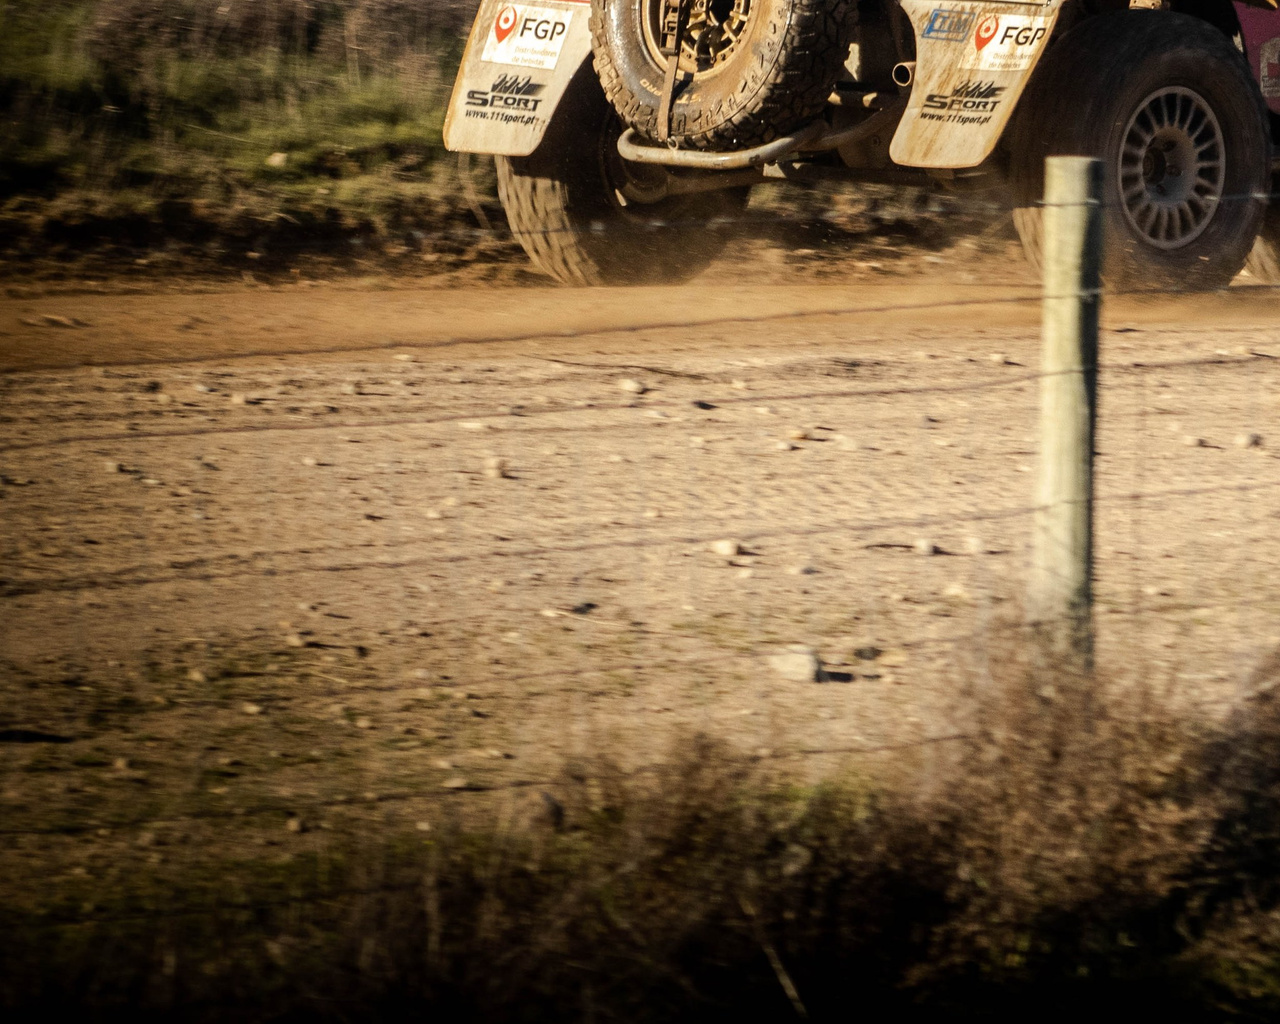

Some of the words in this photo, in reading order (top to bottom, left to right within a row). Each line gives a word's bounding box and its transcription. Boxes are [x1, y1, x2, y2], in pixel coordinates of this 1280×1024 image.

[519, 17, 566, 41] FGP
[999, 26, 1047, 46] FGP
[464, 89, 543, 112] SPORT
[922, 94, 1001, 113] SPORT
